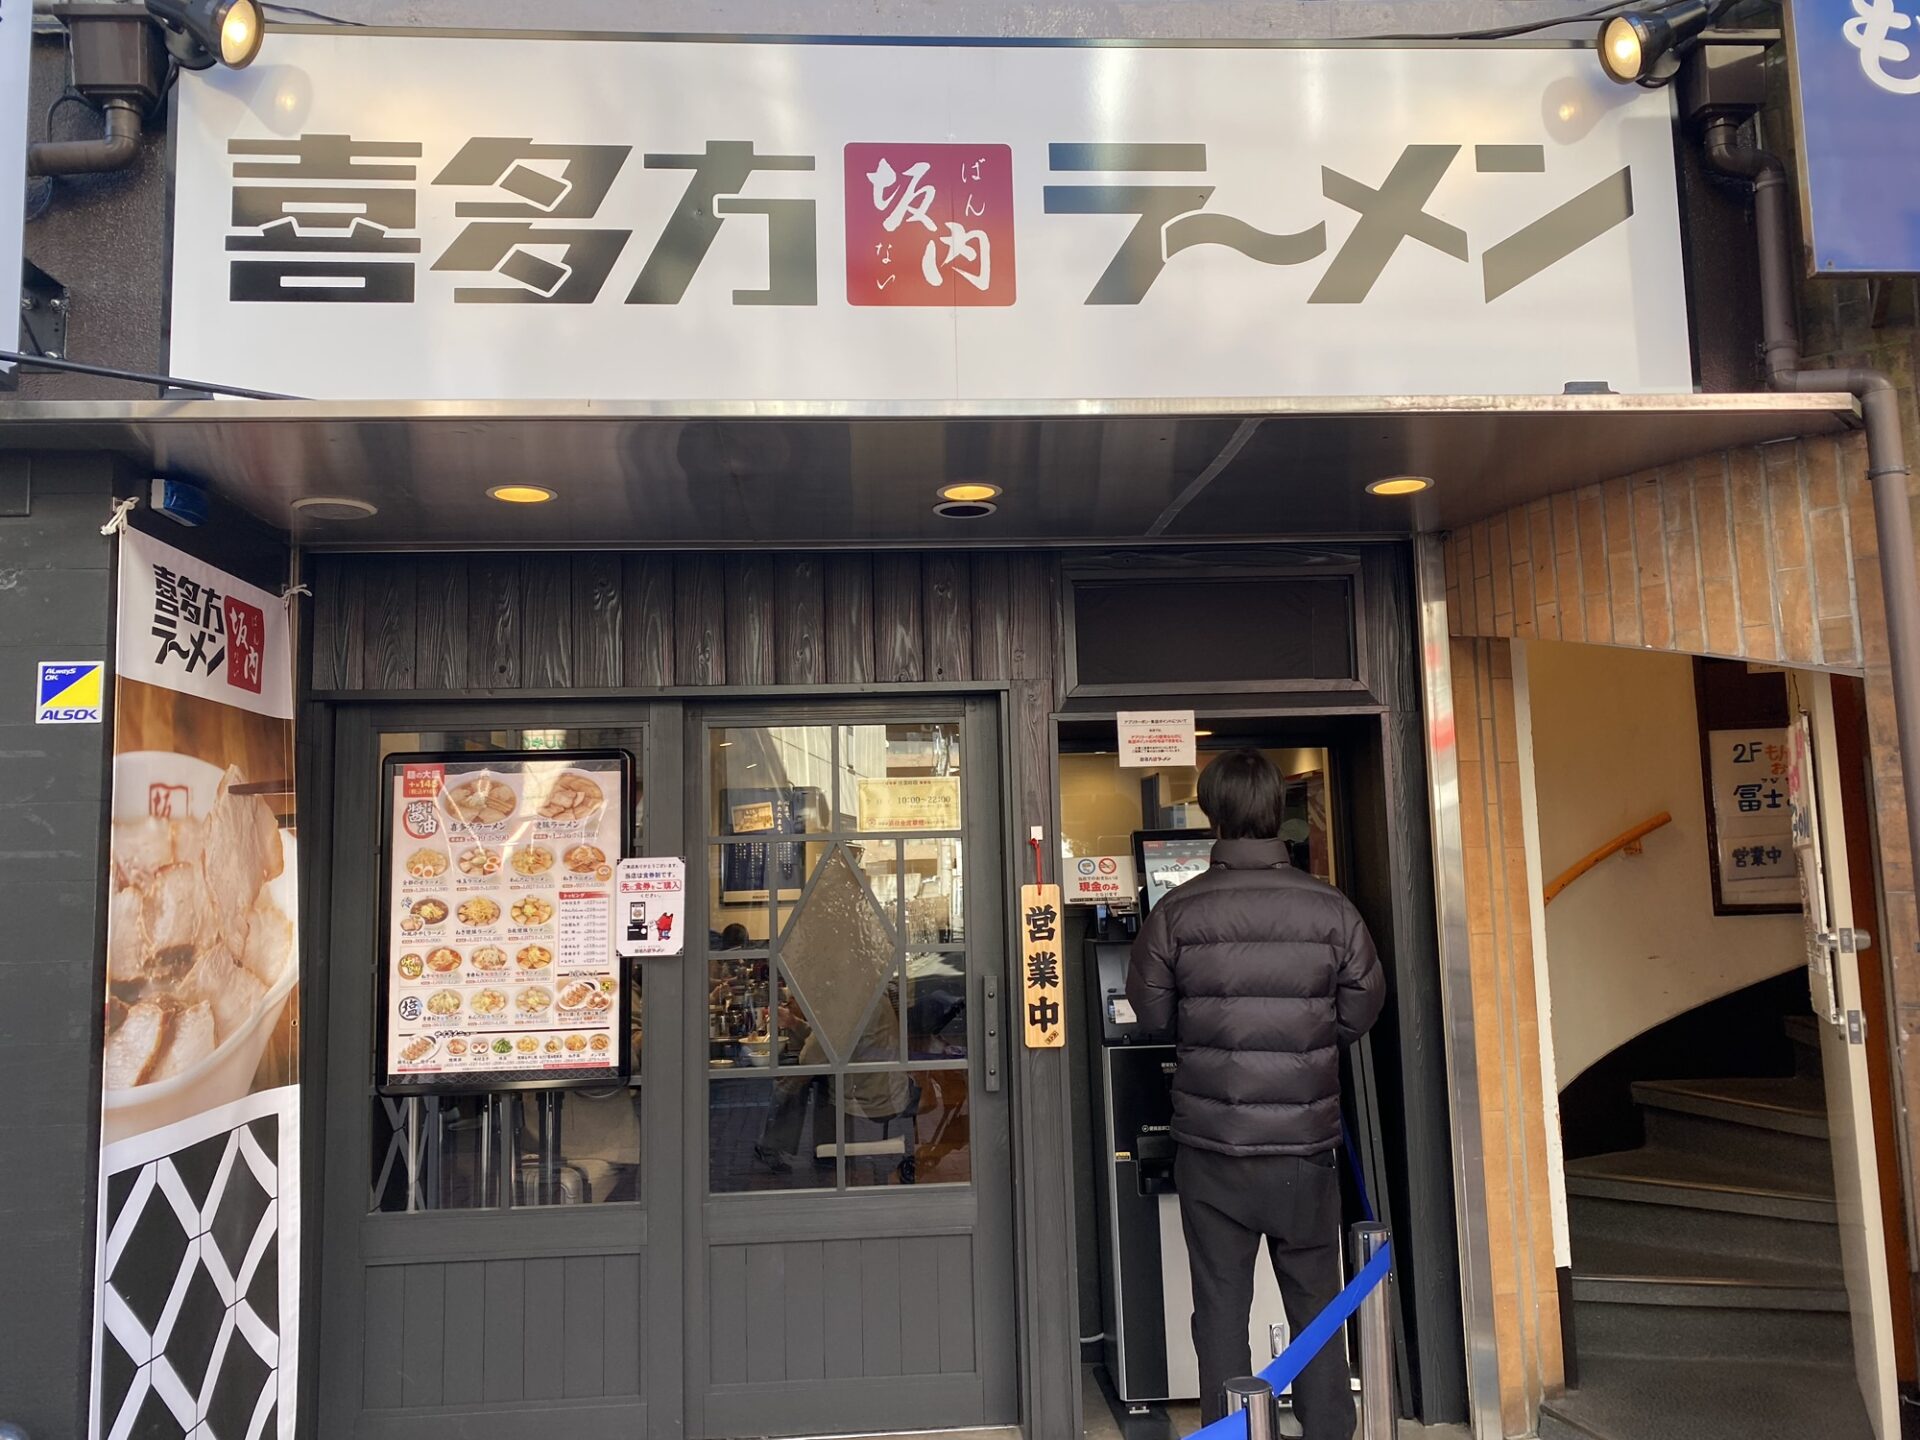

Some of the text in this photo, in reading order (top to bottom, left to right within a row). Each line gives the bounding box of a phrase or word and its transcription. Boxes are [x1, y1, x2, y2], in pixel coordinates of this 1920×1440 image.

[1843, 0, 1920, 94] も
[961, 158, 986, 216] ばん
[225, 134, 817, 305] 喜多方
[866, 158, 990, 290] 坂内
[1043, 143, 1634, 305] ラーメン
[875, 243, 896, 290] ない
[152, 563, 225, 635] 喜多方
[151, 613, 226, 678] ラーメン
[229, 606, 259, 685] 坂内
[40, 709, 97, 720] ALSOK
[1733, 742, 1763, 763] 2F
[1733, 784, 1790, 812] 冨士
[1078, 881, 1119, 892] 現金のみ
[1732, 846, 1782, 867] 営業中
[1025, 903, 1060, 1033] 営業中
[401, 1000, 420, 1018] 塩
